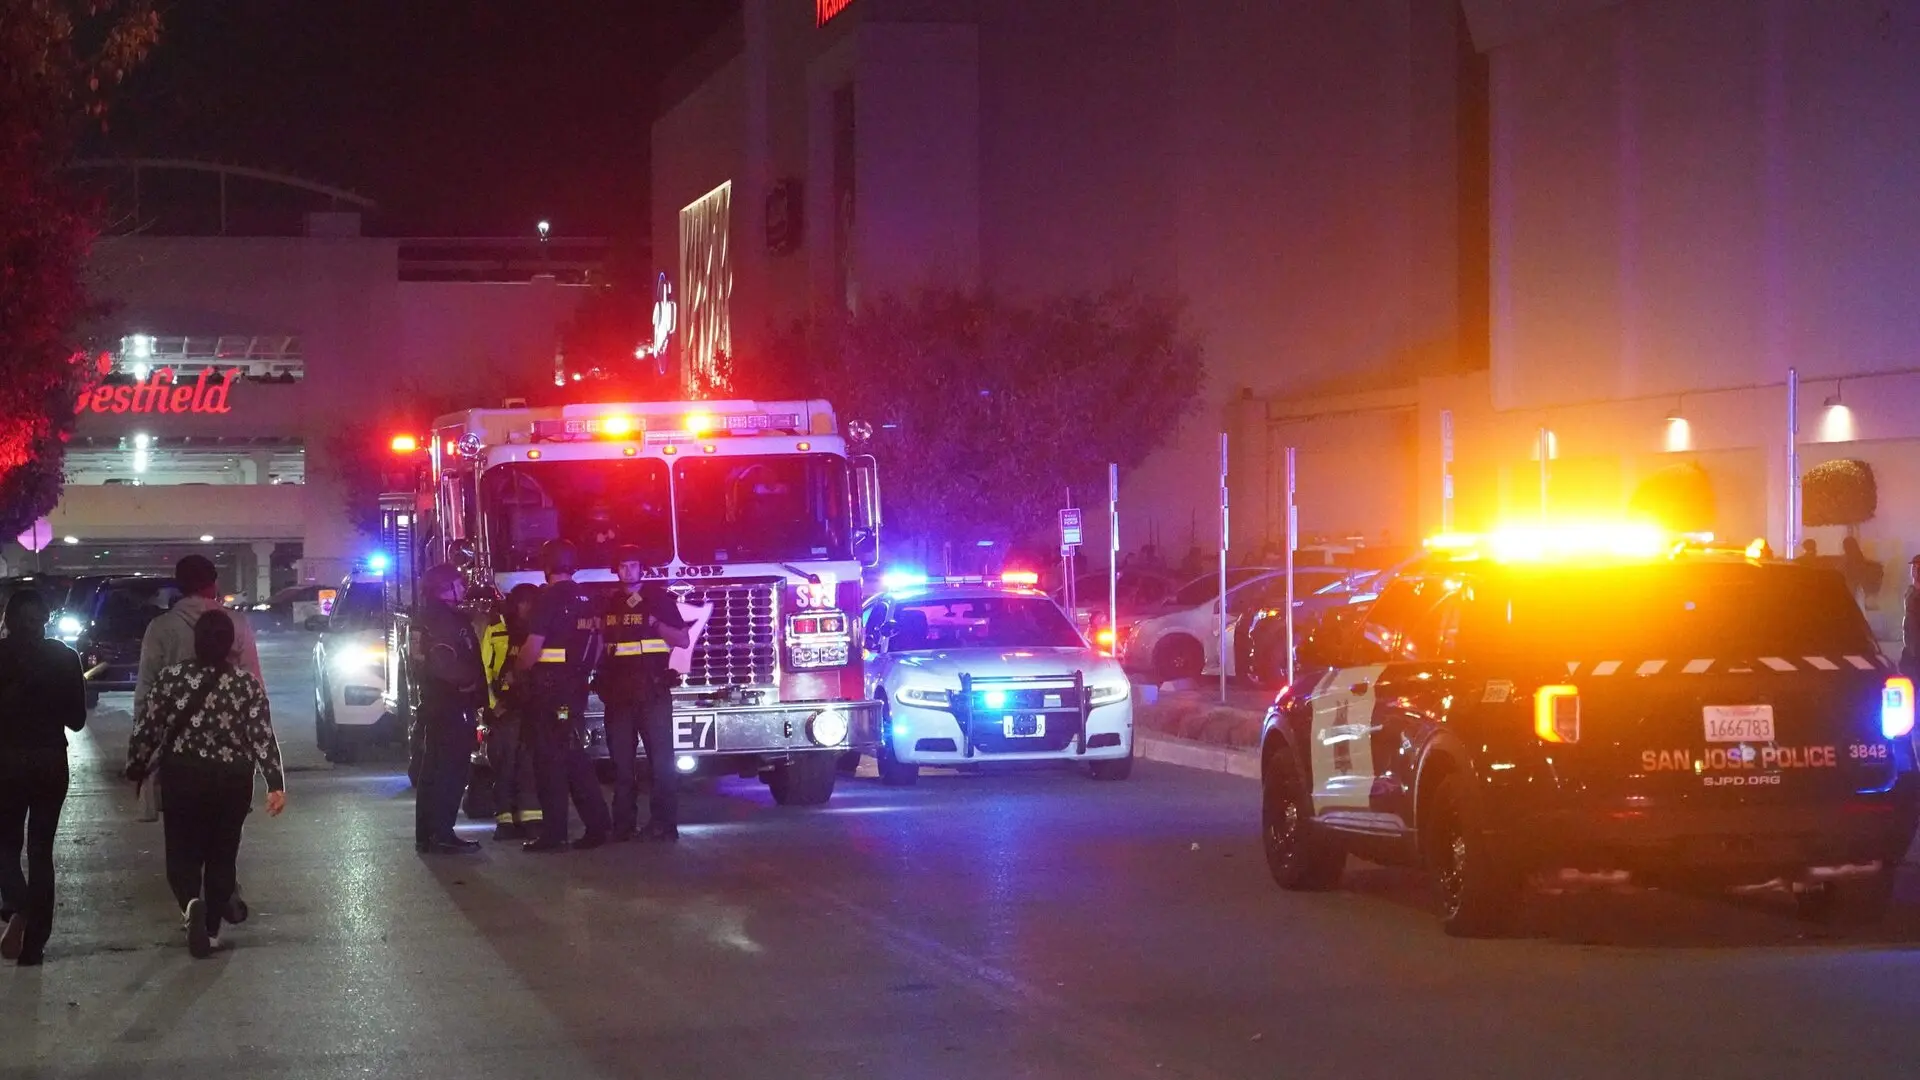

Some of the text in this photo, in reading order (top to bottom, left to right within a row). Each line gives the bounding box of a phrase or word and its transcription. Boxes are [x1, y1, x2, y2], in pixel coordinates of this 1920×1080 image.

[676, 566, 724, 577] JOSE
[672, 715, 713, 749] E7
[1710, 720, 1770, 737] 1666783
[1641, 749, 1691, 771] SAN
[1761, 746, 1837, 769] POLICE
[1849, 744, 1887, 759] 3842
[1703, 775, 1781, 786] SJPD.ORG
